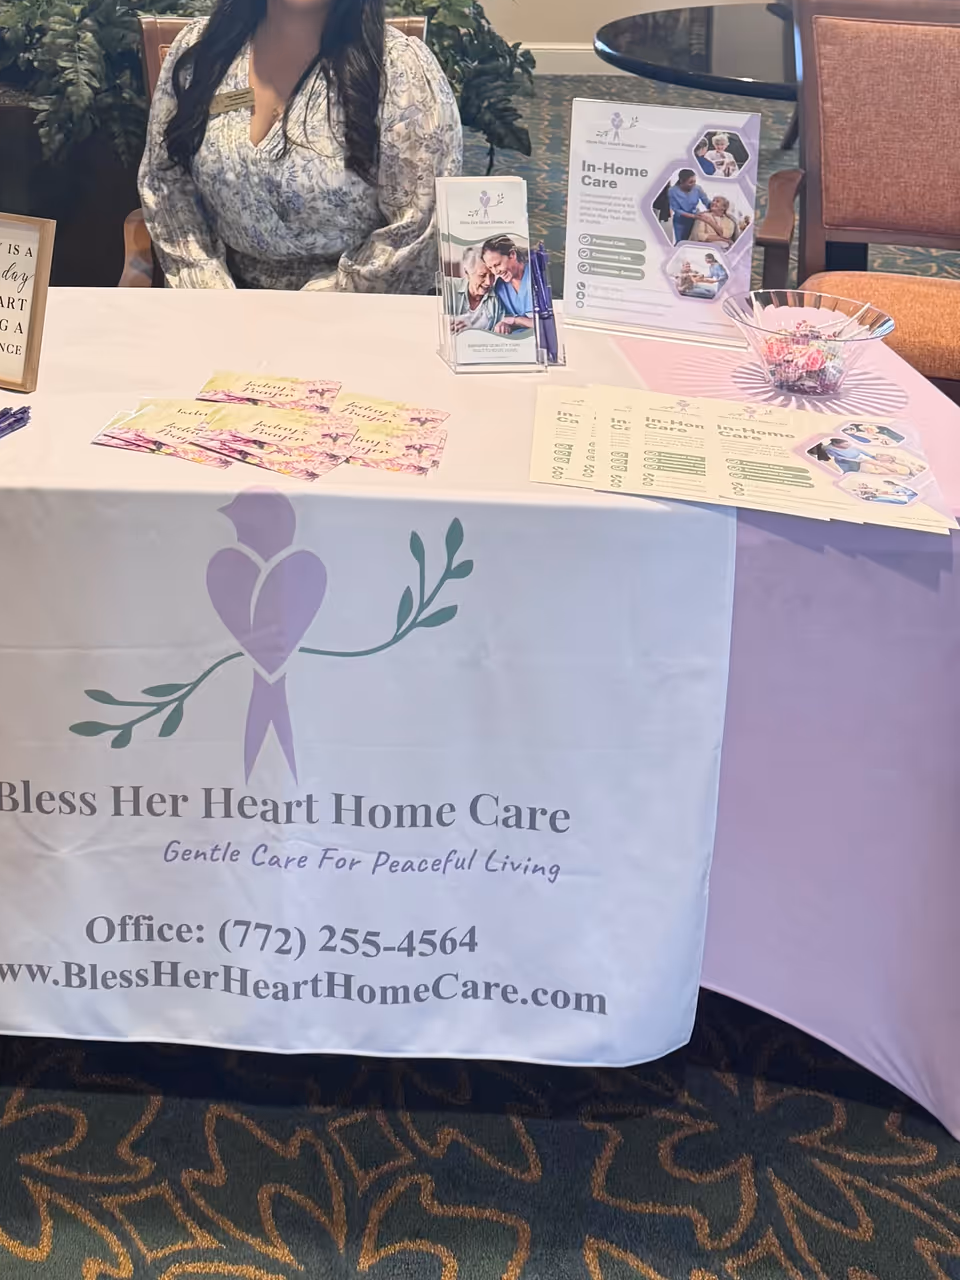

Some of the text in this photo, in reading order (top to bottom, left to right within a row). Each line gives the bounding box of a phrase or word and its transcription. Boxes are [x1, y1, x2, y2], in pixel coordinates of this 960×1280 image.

[582, 160, 649, 177] In-Home
[581, 175, 618, 189] Care
[8, 244, 20, 255] IS
[25, 247, 33, 257] A
[2, 262, 34, 293] day
[14, 322, 24, 334] A
[111, 786, 188, 817] Her
[202, 788, 319, 824] Heart
[332, 793, 455, 828] Home
[470, 794, 570, 833] Care
[164, 840, 560, 883] Gentle Care For Peaceful Living
[86, 915, 477, 960] Office: (772) 255-4564
